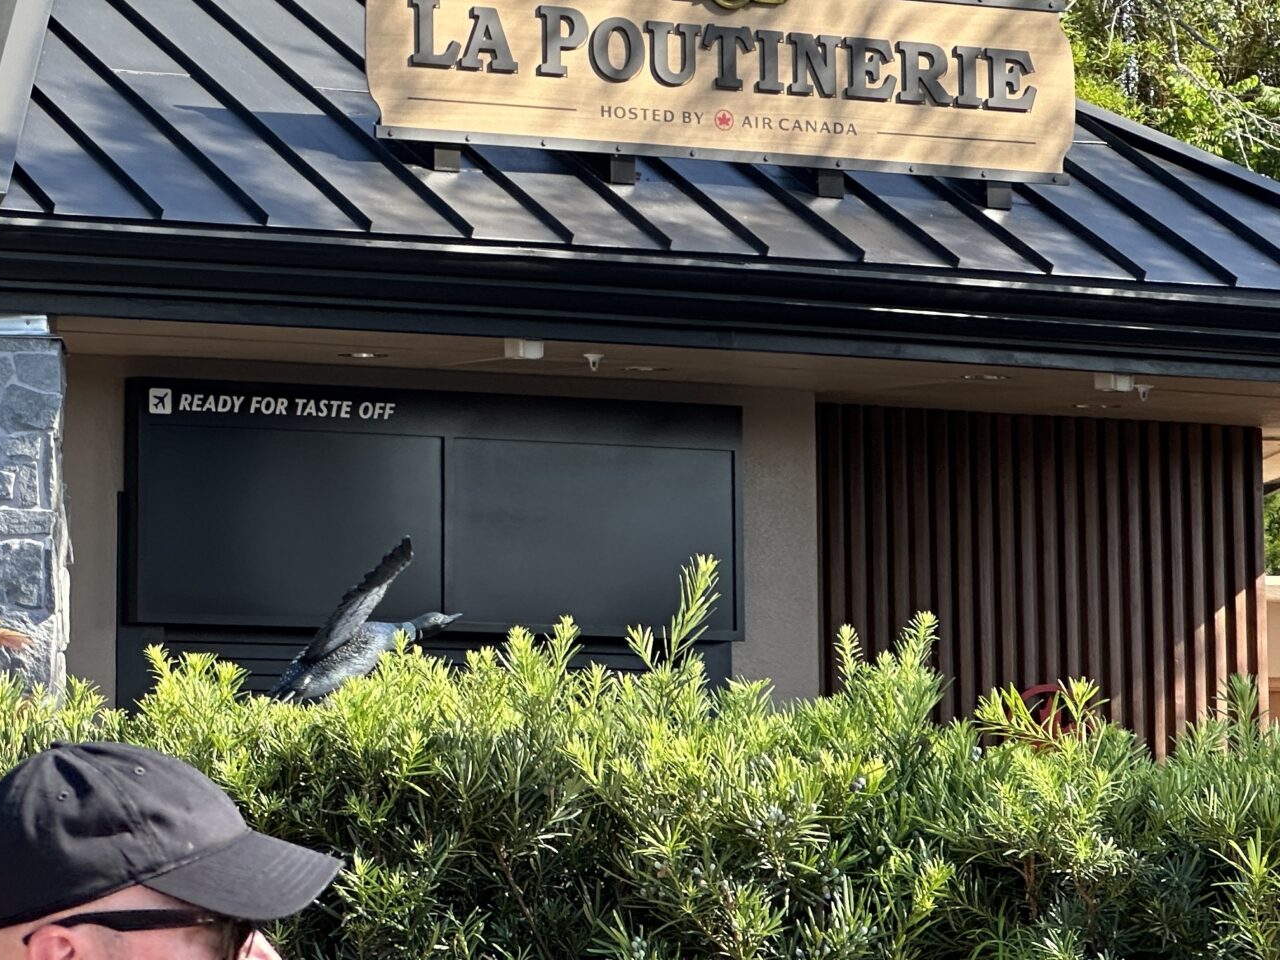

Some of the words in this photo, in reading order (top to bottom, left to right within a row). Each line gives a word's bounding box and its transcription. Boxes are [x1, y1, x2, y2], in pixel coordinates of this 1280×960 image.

[535, 5, 1038, 113] POUTINERIE
[600, 105, 675, 123] HOSTED
[682, 109, 704, 126] BY
[741, 115, 774, 131] AIR
[780, 118, 859, 136] CANADA
[179, 393, 244, 413] READY
[250, 397, 289, 415] FOR
[295, 398, 352, 418] TASTE
[358, 401, 396, 419] OFF
